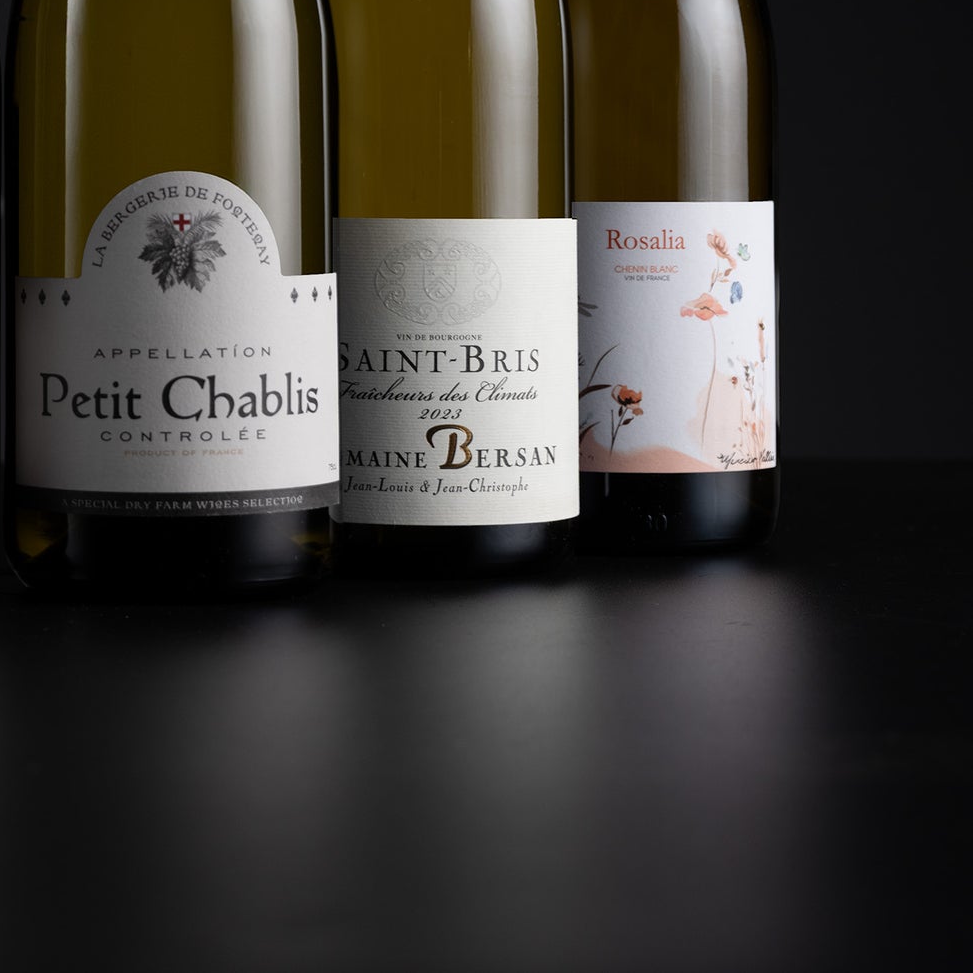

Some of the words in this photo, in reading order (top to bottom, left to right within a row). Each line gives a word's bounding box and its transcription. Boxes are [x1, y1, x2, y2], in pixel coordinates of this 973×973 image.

[92, 245, 108, 268] LA
[185, 185, 209, 201] DE
[605, 228, 686, 251] Rosalia
[613, 264, 648, 274] CHENIN
[649, 265, 679, 274] BLANC
[623, 274, 635, 282] VIN
[635, 274, 645, 282] DE
[645, 274, 671, 282] FRANCE
[396, 333, 413, 342] VIN
[414, 333, 426, 342] DE
[429, 333, 483, 342] BOURGOGNE
[40, 372, 142, 420] Petit
[161, 372, 319, 422] Chablis
[439, 382, 470, 402] des
[475, 377, 539, 403] Climats
[418, 408, 463, 421] 2023
[100, 427, 267, 443] CONTROLÉE
[124, 449, 177, 457] PRODUCT
[181, 449, 197, 457] OF
[202, 448, 244, 457] FRANCE
[345, 449, 428, 469] MAINE
[425, 423, 558, 471] BERSAN
[344, 475, 414, 493] Jean-Louis
[419, 479, 431, 494] &
[433, 477, 529, 497] Jean-Christophe
[124, 500, 151, 511] DRY
[155, 500, 192, 511] FARM
